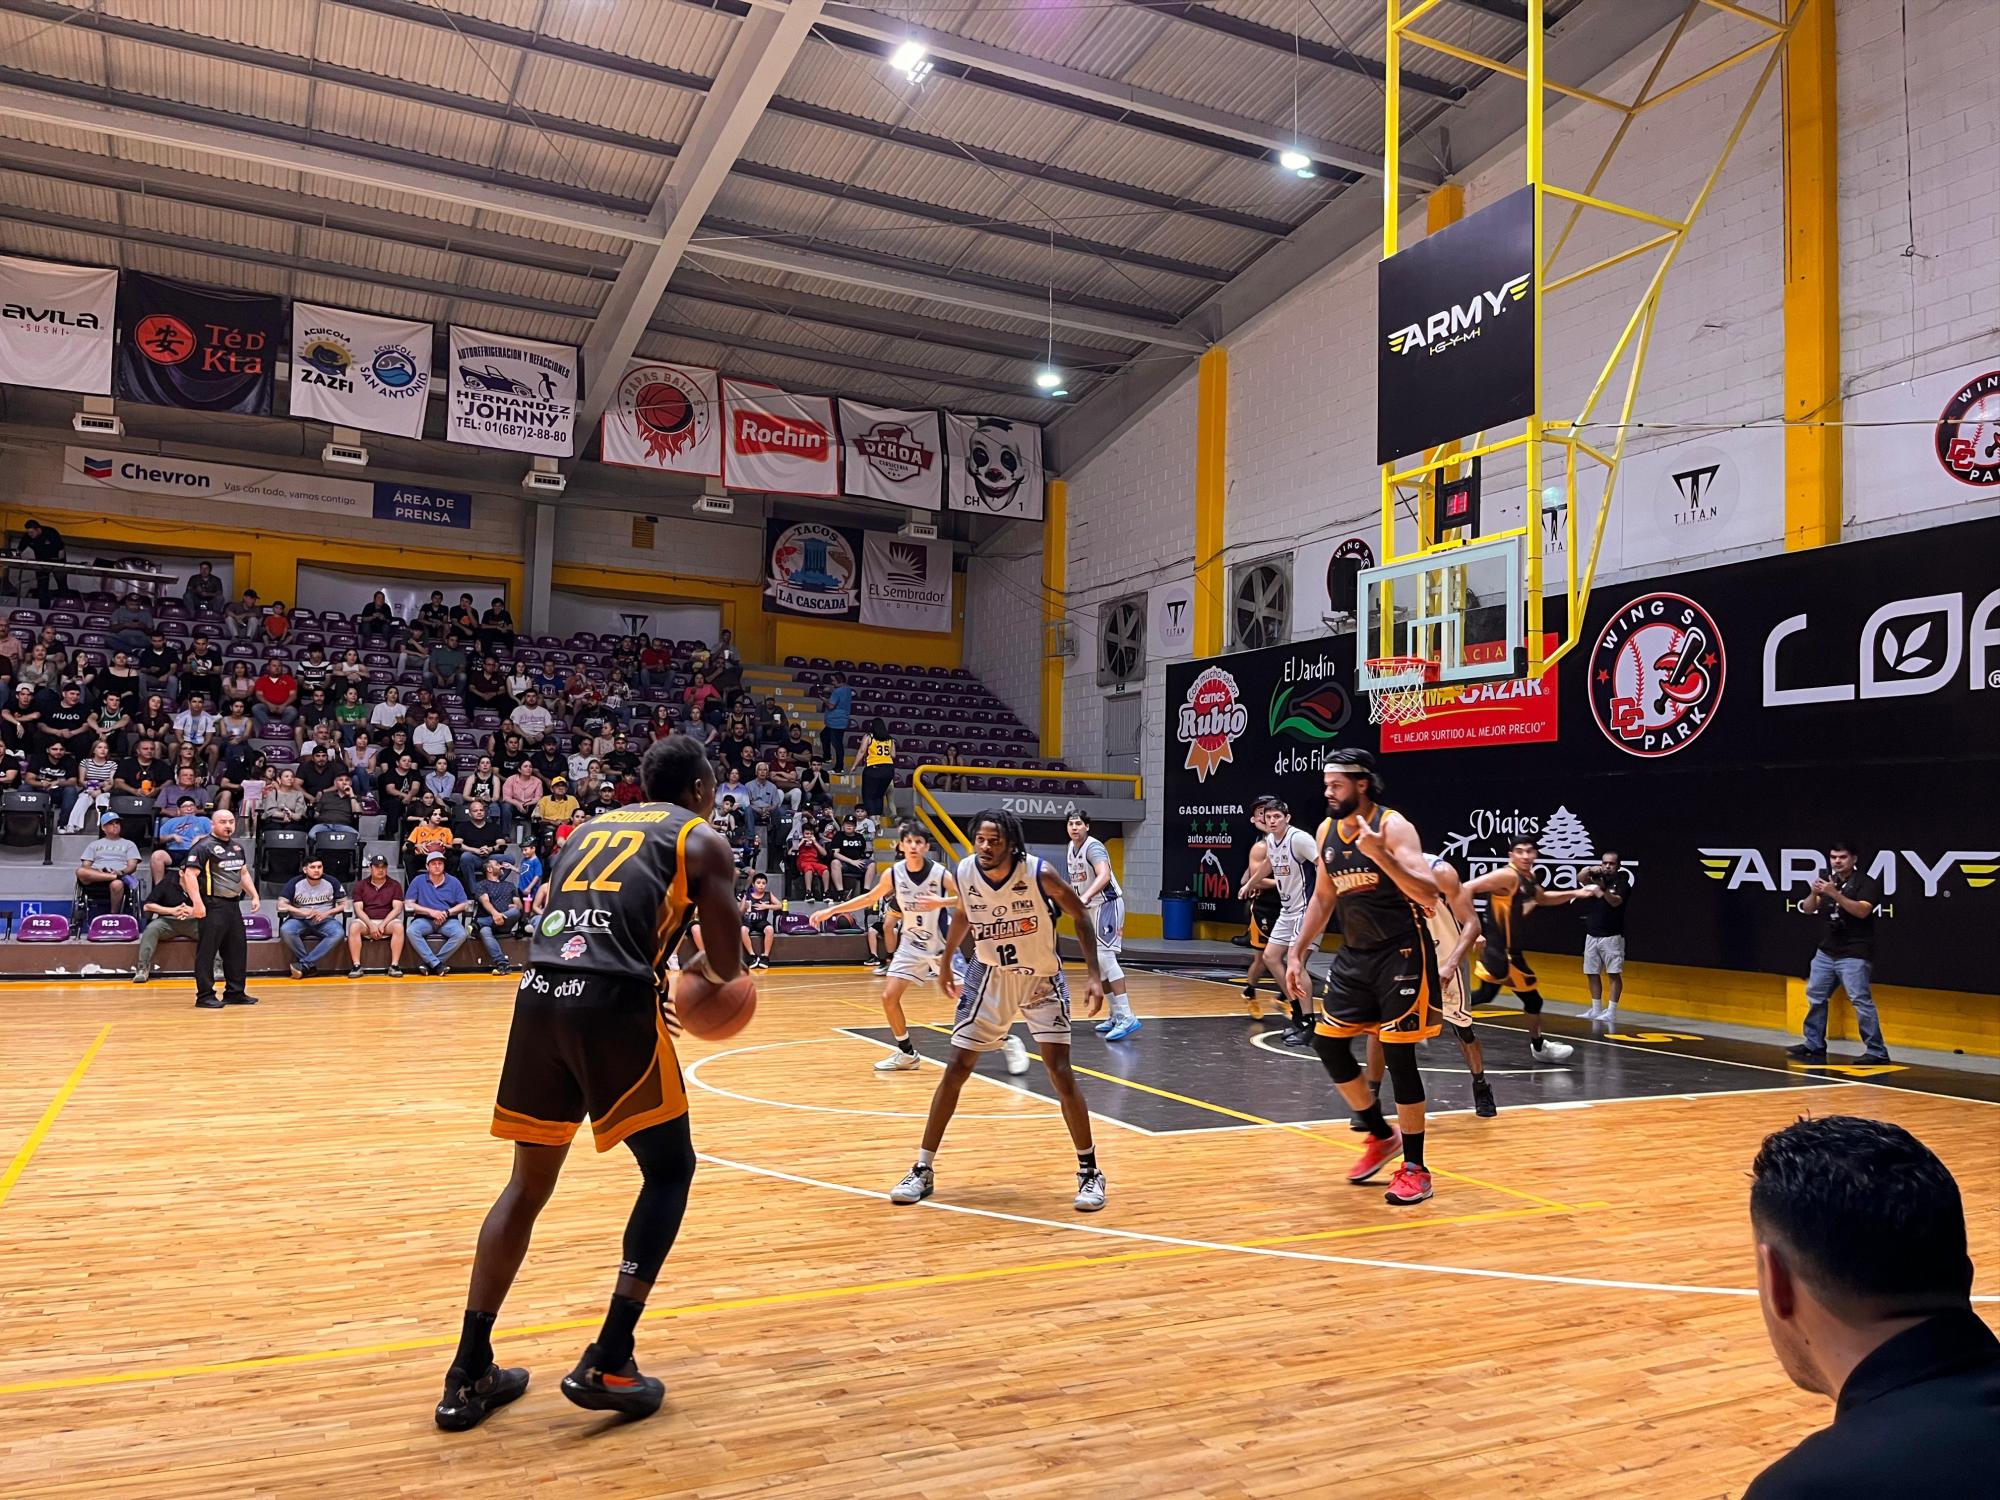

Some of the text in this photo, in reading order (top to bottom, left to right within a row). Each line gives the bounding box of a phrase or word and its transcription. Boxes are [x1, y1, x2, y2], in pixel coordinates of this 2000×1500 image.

[1388, 273, 1531, 355] ARMY
[26, 324, 64, 335] SUSHI
[304, 327, 351, 343] ACUICOLA
[201, 347, 263, 374] Kta
[374, 344, 416, 361] ACUICOLA
[301, 369, 353, 394] ZAZFI
[360, 366, 428, 399] SAN ANTONIO
[1958, 376, 2000, 403] WIN
[456, 390, 571, 415] HERNANDEZ
[456, 416, 567, 443] TEL: 01(687)2-88-80
[741, 419, 820, 448] Rochin
[864, 441, 923, 466] OCHOA
[120, 463, 210, 489] Chevron
[223, 482, 241, 492] Vas
[243, 486, 260, 494] con
[289, 492, 319, 502] vamos
[393, 490, 455, 509] ÁREA DE
[964, 495, 980, 507] CH
[395, 506, 451, 523] PRENSA
[1674, 506, 1718, 525] TITAN
[794, 525, 838, 542] TACOS
[778, 589, 847, 610] LA CASCADA
[869, 584, 945, 602] El Sembrador
[1284, 654, 1335, 682] El Jardín
[52, 711, 81, 721] HUGO
[1180, 704, 1246, 738] Rubio
[1404, 732, 1429, 743] MEJOR
[1431, 729, 1465, 741] SURTIDO
[1466, 728, 1476, 738] AL
[1478, 725, 1506, 738] MEJOR
[1644, 707, 1706, 750] PARK
[876, 746, 890, 756] 35
[1274, 750, 1289, 776] de
[1292, 747, 1308, 772] los
[1000, 797, 1079, 816] ZONA-A
[1179, 805, 1244, 815] GASOLINERA
[1469, 809, 1539, 840] Viajes
[1187, 832, 1233, 844] auto servicio
[561, 830, 645, 893] 22
[32, 919, 51, 927] R22
[101, 919, 120, 927] R23
[916, 915, 923, 927] 9
[996, 943, 1019, 967] 12
